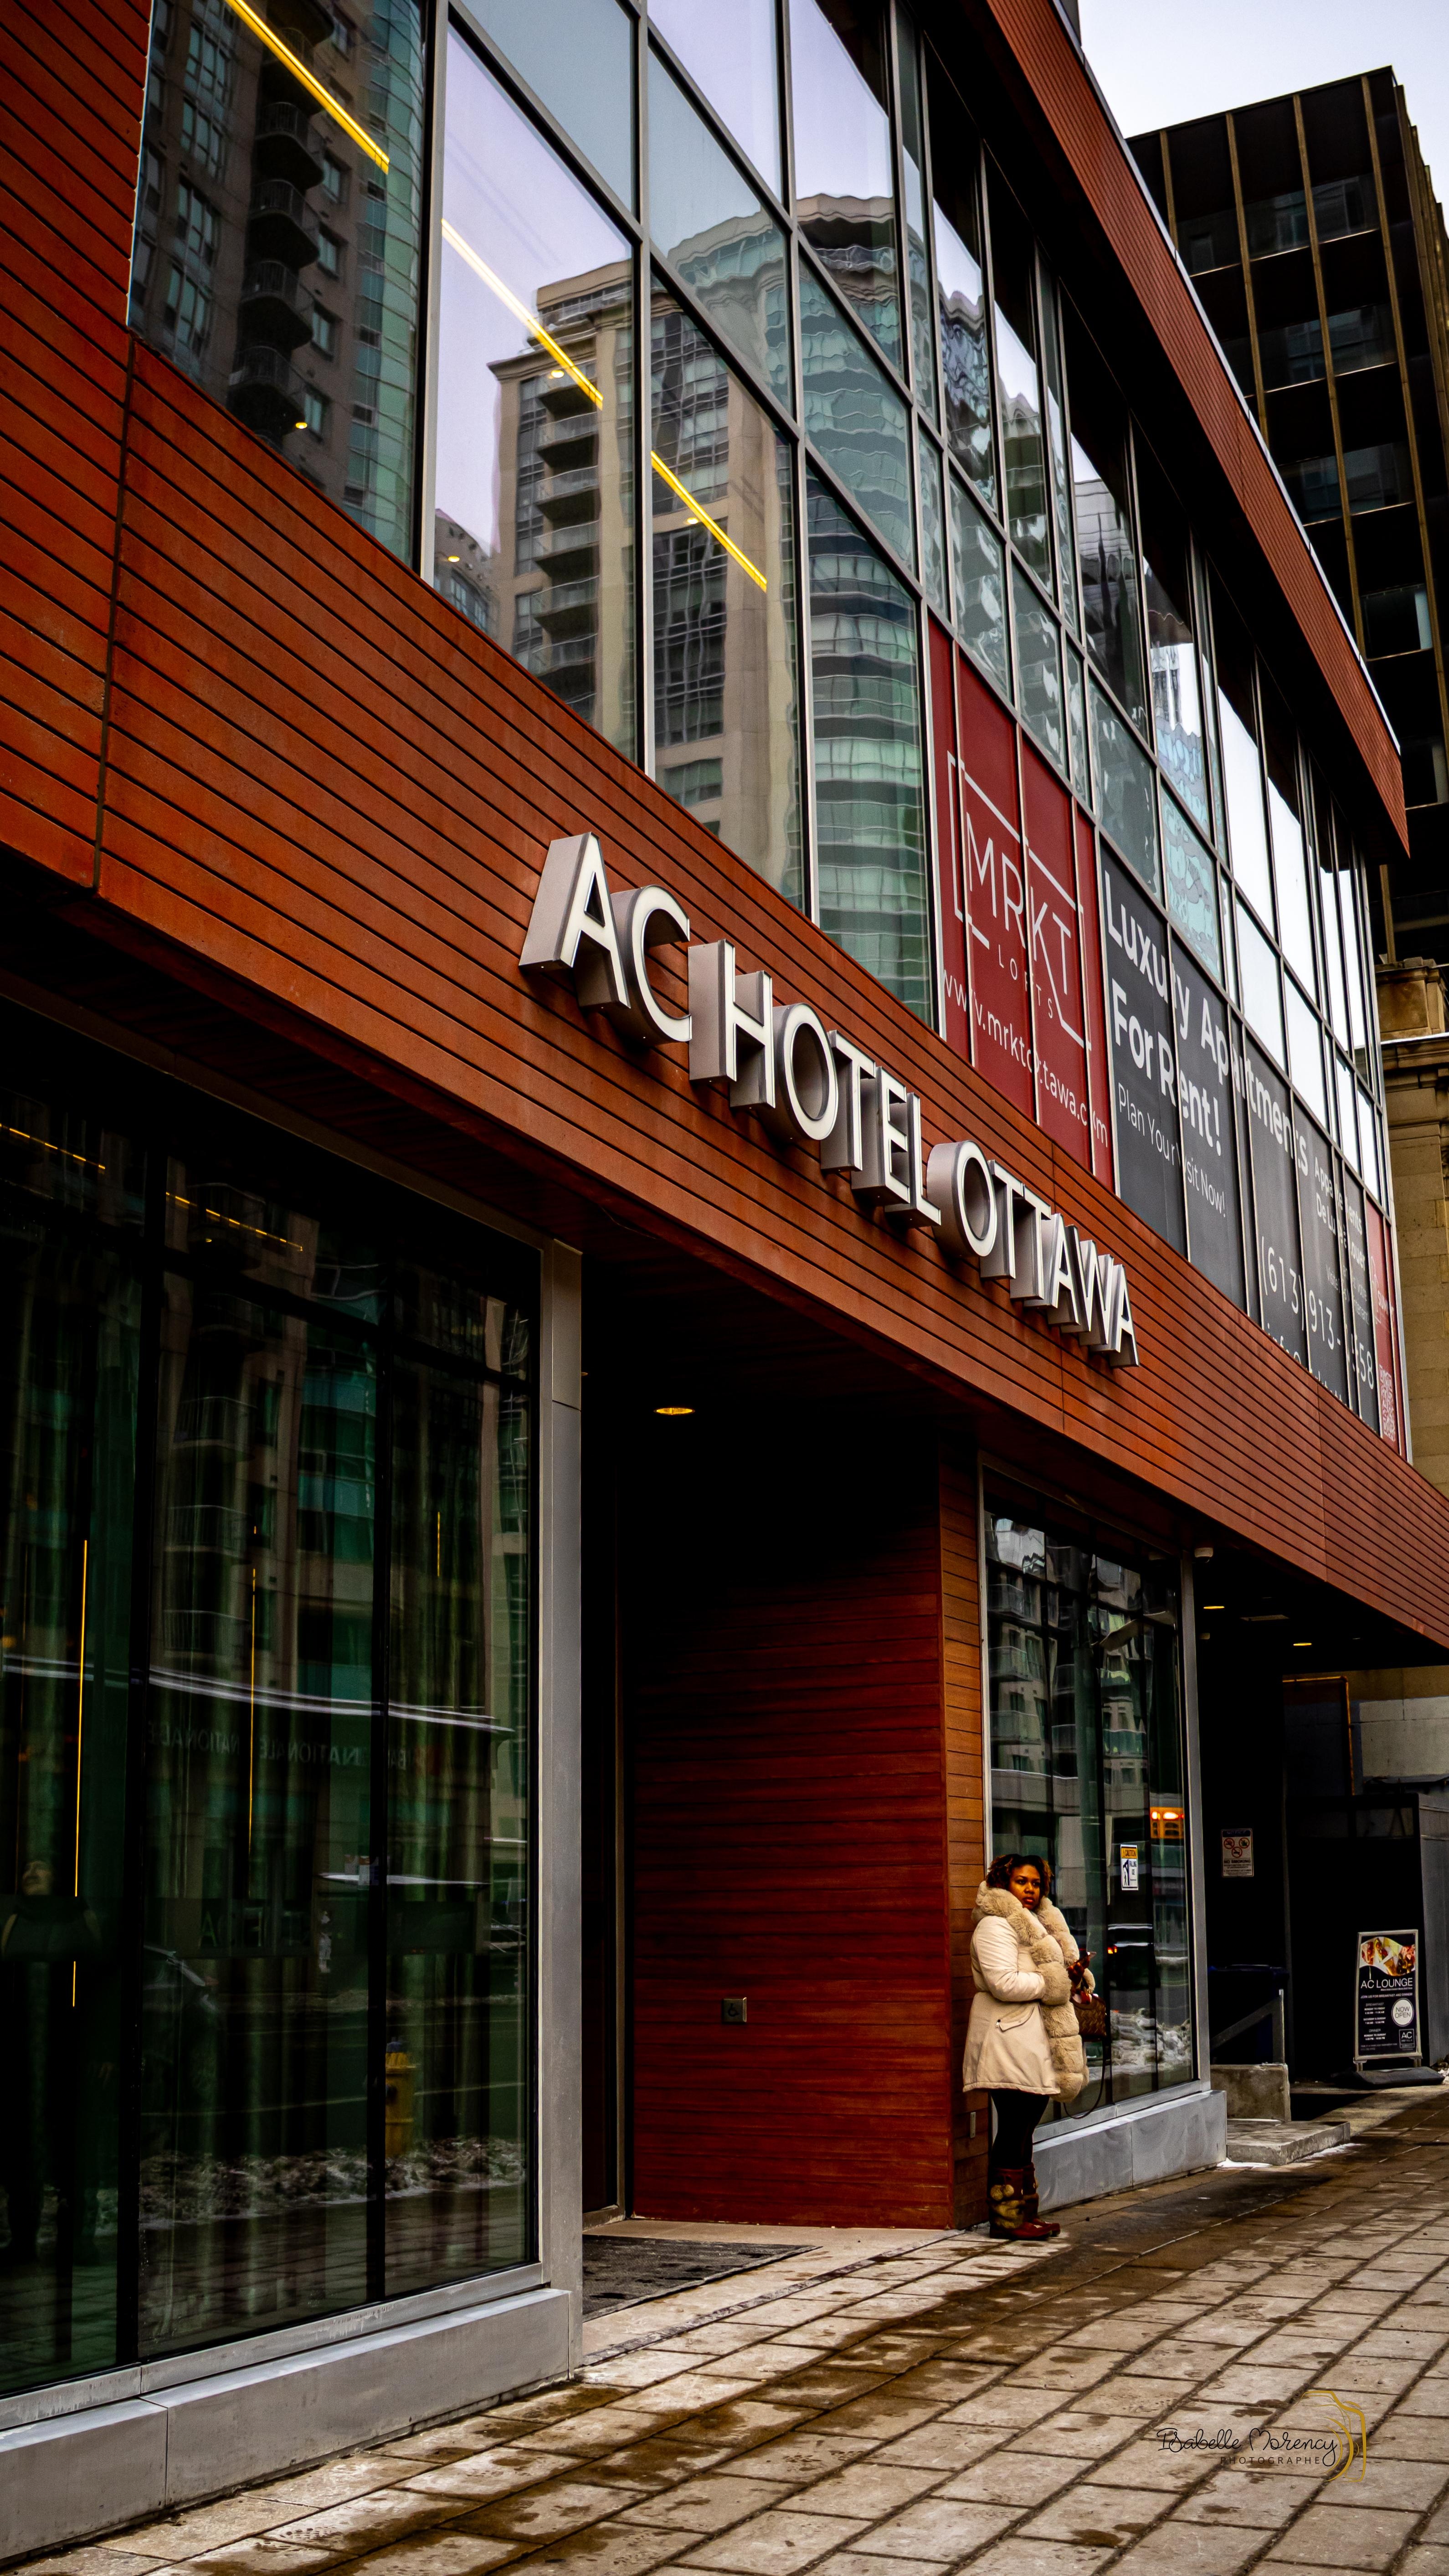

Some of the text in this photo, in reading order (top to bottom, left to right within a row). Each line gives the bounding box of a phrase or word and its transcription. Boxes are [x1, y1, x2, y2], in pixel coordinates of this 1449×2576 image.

[966, 812, 1071, 995] MRKT
[519, 831, 1139, 1368] AC HOTEL OTTAWA
[1112, 978, 1222, 1156] For Rent!
[1118, 1082, 1145, 1136] Plan
[1147, 1112, 1175, 1166] Your
[1200, 1168, 1226, 1218] Now!
[1316, 1192, 1326, 1224] De
[1261, 1236, 1304, 1331] (613)
[1361, 1978, 1413, 1989] AC LOUNGE
